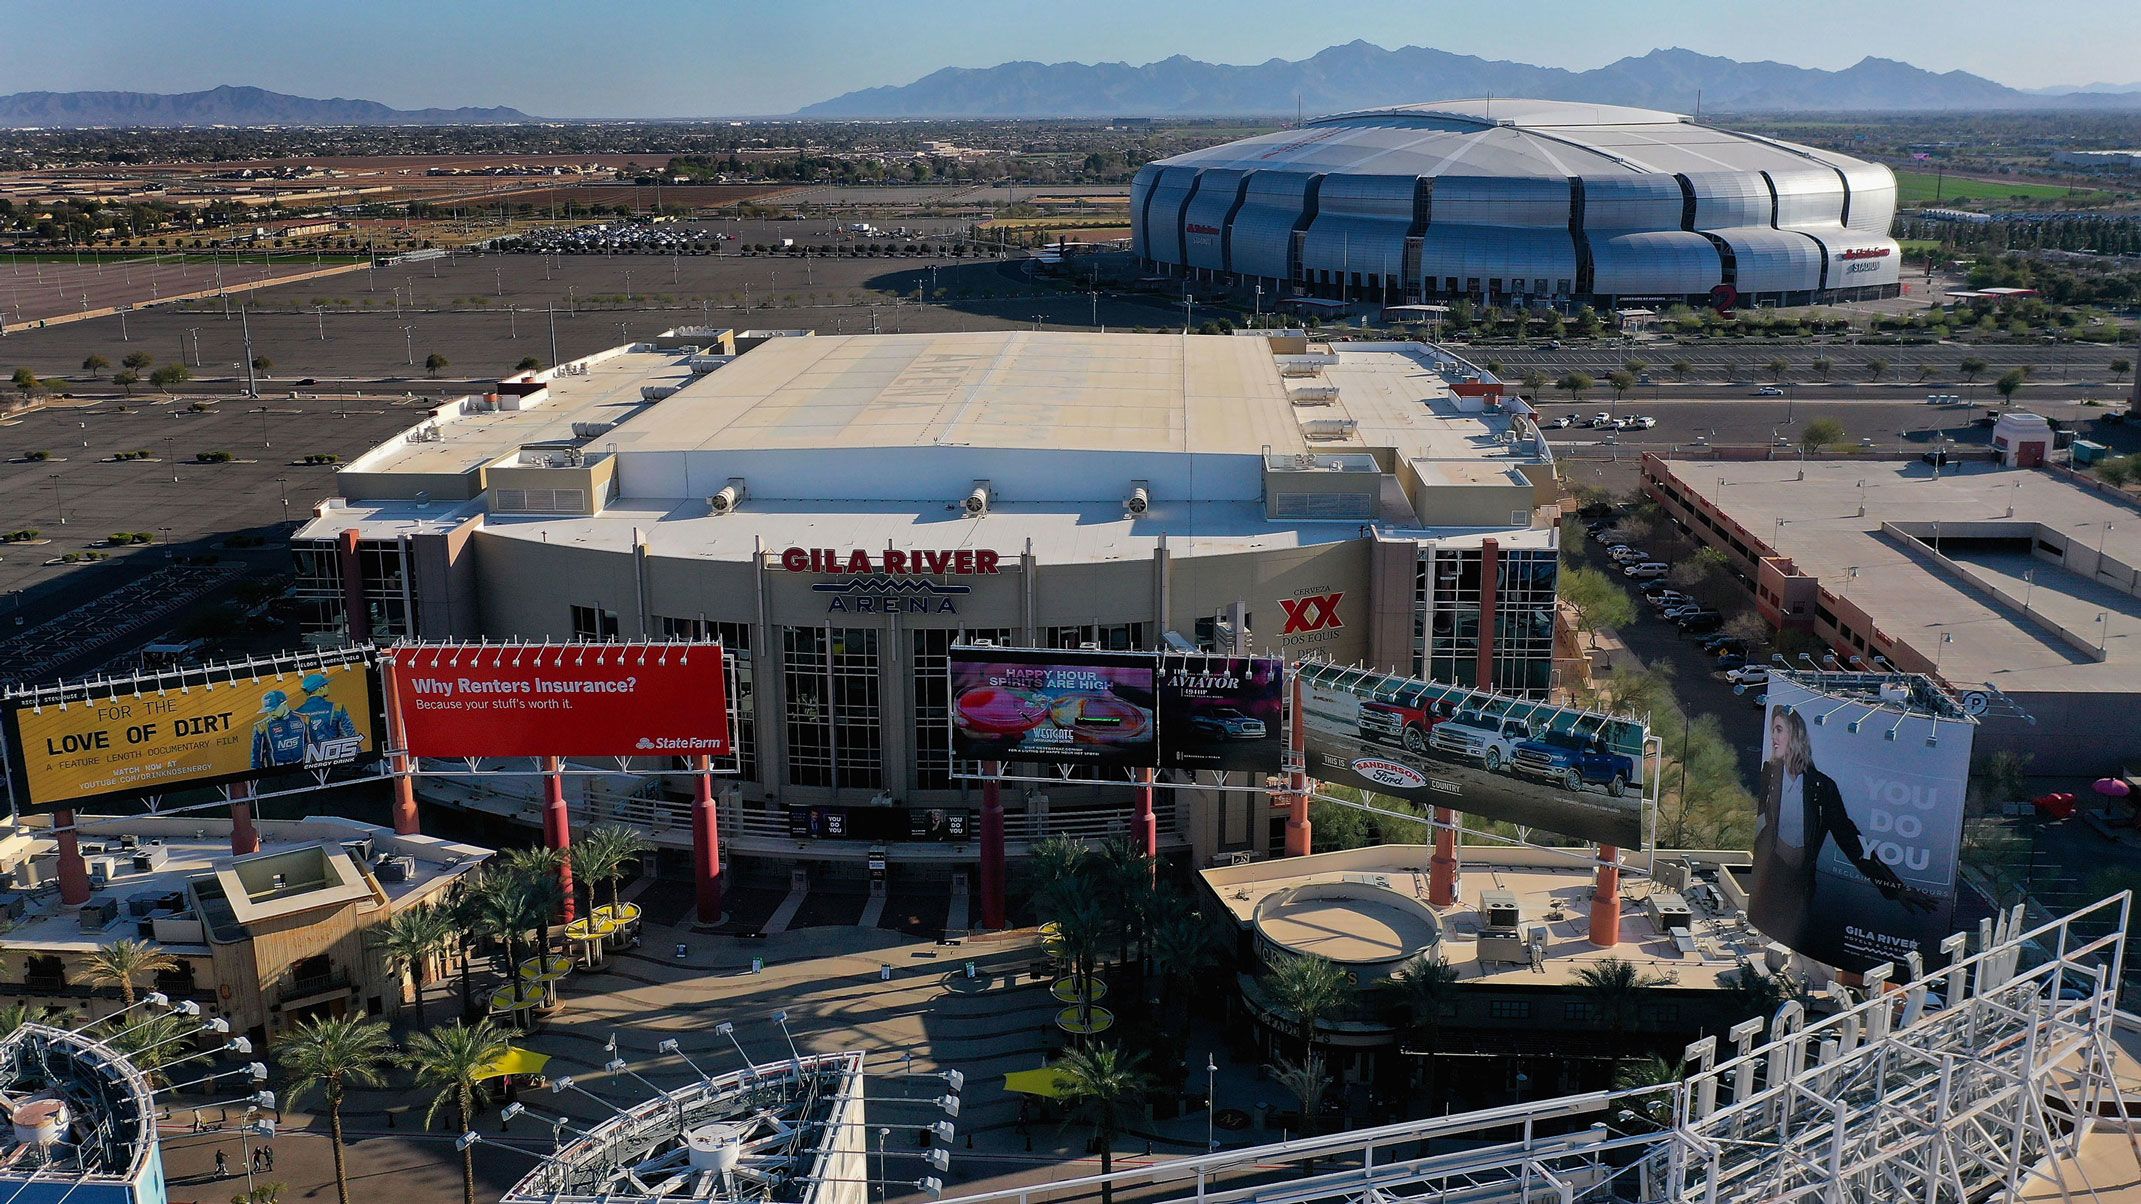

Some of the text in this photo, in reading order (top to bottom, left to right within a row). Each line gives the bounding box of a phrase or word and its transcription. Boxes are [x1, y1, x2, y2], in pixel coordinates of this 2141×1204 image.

[782, 547, 1001, 575] GILA RIVER
[1293, 585, 1331, 597] CERVEZA
[826, 595, 959, 616] ARENA
[1277, 591, 1346, 636] XX
[1282, 630, 1340, 647] DOS EQUIS
[989, 677, 1114, 690] SPIRITS ARE HIGH
[1006, 668, 1097, 681] HAPPY HOUR
[1167, 676, 1240, 689] AVIATOR
[411, 677, 637, 697] Why Renters Insurance?
[98, 698, 177, 722] FOR THE
[416, 698, 573, 711] Because your stuff's worth it.
[46, 712, 233, 756] LOVE OF DIRT
[1032, 727, 1074, 740] WESTGATE
[46, 735, 239, 772] A FEATURE LENGTH DOCUMENTARY FILM
[305, 735, 361, 764] NOS
[112, 760, 177, 776] WATCH NOW AT
[304, 757, 355, 770] ENERGY DRINK
[1323, 755, 1345, 767] THIS IS
[1356, 761, 1421, 784] SANDERSON
[1372, 769, 1404, 786] Ford
[1431, 780, 1461, 793] COUNTRY
[1861, 775, 1937, 811] YOU
[1869, 807, 1923, 839] DO
[1857, 835, 1930, 872] YOU
[1832, 866, 1949, 897] RECLAIM WHAT'S YOURS
[1845, 925, 1919, 949] GILA RIVER
